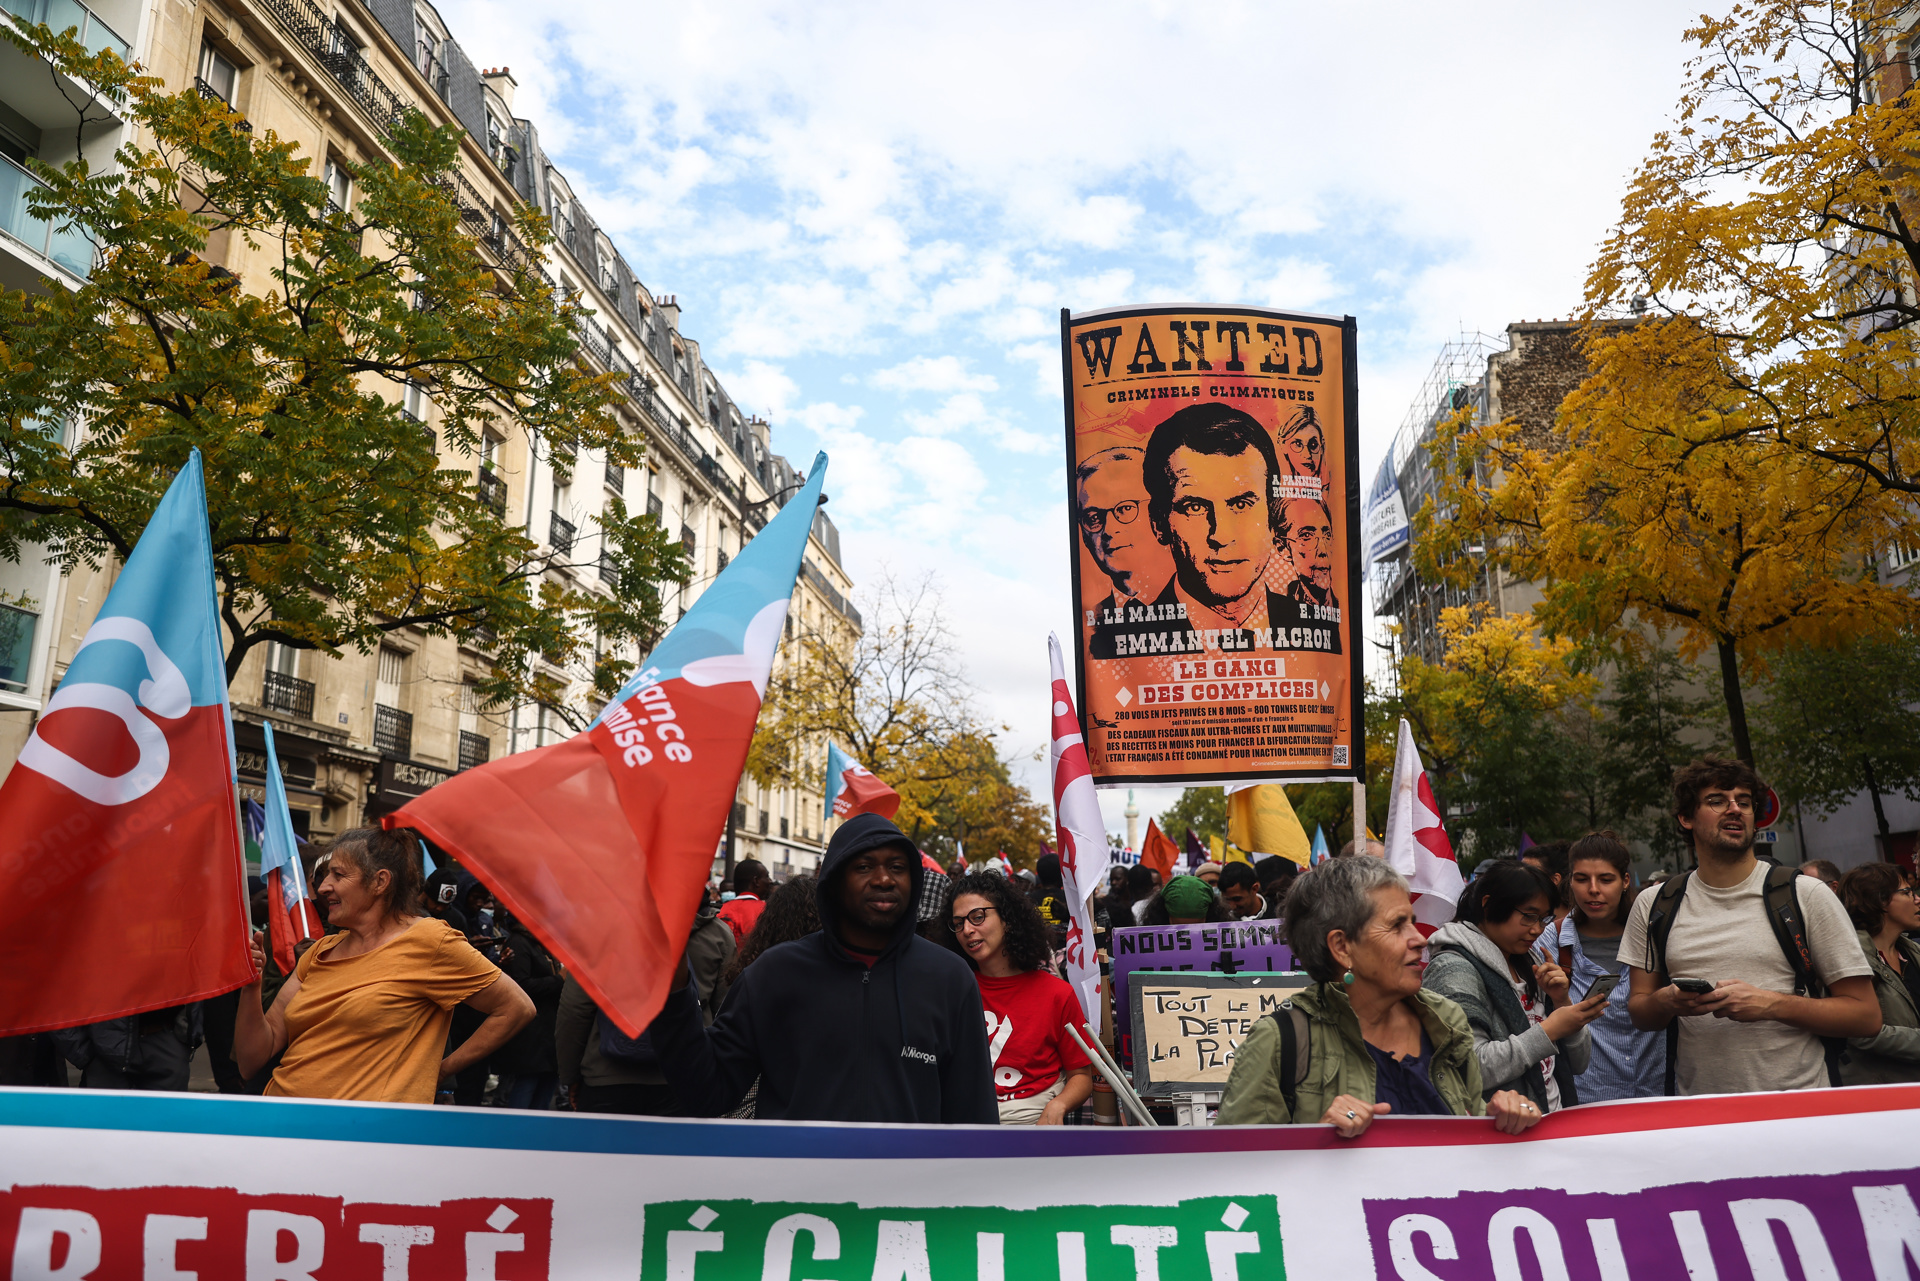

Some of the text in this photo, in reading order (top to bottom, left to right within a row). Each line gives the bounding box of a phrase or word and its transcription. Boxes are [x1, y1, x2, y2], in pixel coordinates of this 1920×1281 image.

[1075, 321, 1323, 379] WANTED
[1108, 386, 1315, 403] CRIMINELS CLIMATIQUES
[1272, 474, 1322, 488] A. PANNIER
[1272, 487, 1322, 500] RUNACHER
[1086, 603, 1187, 626] B. LE MAIRE
[1299, 603, 1342, 623] E. BORNE
[1114, 627, 1331, 655] EMMANUEL MACRON
[1180, 660, 1276, 679] LE GANG
[1144, 682, 1314, 703] DES COMPLICES
[1115, 711, 1129, 720] 280
[1132, 710, 1149, 719] VOLS
[1151, 710, 1159, 718] EN
[1161, 709, 1177, 718] JETS
[1180, 706, 1206, 717] PRIVÉS
[1208, 707, 1217, 717] EN
[1219, 707, 1224, 715] 8
[1226, 706, 1246, 715] MOIS
[1254, 705, 1269, 714] 800
[1271, 704, 1298, 714] TONNES
[1299, 704, 1307, 714] DE
[1107, 730, 1122, 739] DES
[1123, 729, 1157, 739] CADEAUX
[1157, 728, 1189, 738] FISCAUX
[1190, 727, 1206, 737] AUX
[1207, 725, 1261, 736] ULTRA-RICHES
[1262, 725, 1270, 734] ET
[1272, 724, 1287, 734] AUX
[1106, 742, 1120, 751] DES
[1121, 741, 1157, 751] RECETTES
[1158, 740, 1168, 750] EN
[1169, 740, 1194, 749] MOINS
[1196, 738, 1217, 748] POUR
[1218, 737, 1255, 748] FINANCER
[1256, 737, 1266, 746] LA
[1268, 735, 1310, 746] BIFURCATION
[1105, 753, 1126, 762] L'ETAT
[1127, 752, 1164, 763] FRANÇAIS
[1165, 752, 1171, 761] A
[1172, 750, 1185, 761] ÉTÉ
[1186, 749, 1228, 760] CONDAMNÉ
[1230, 749, 1250, 758] POUR
[1252, 748, 1287, 758] INACTION
[1288, 747, 1321, 757] CLIMATIQUE
[1119, 930, 1192, 955] NOUS
[1178, 1015, 1252, 1037] DÉTE
